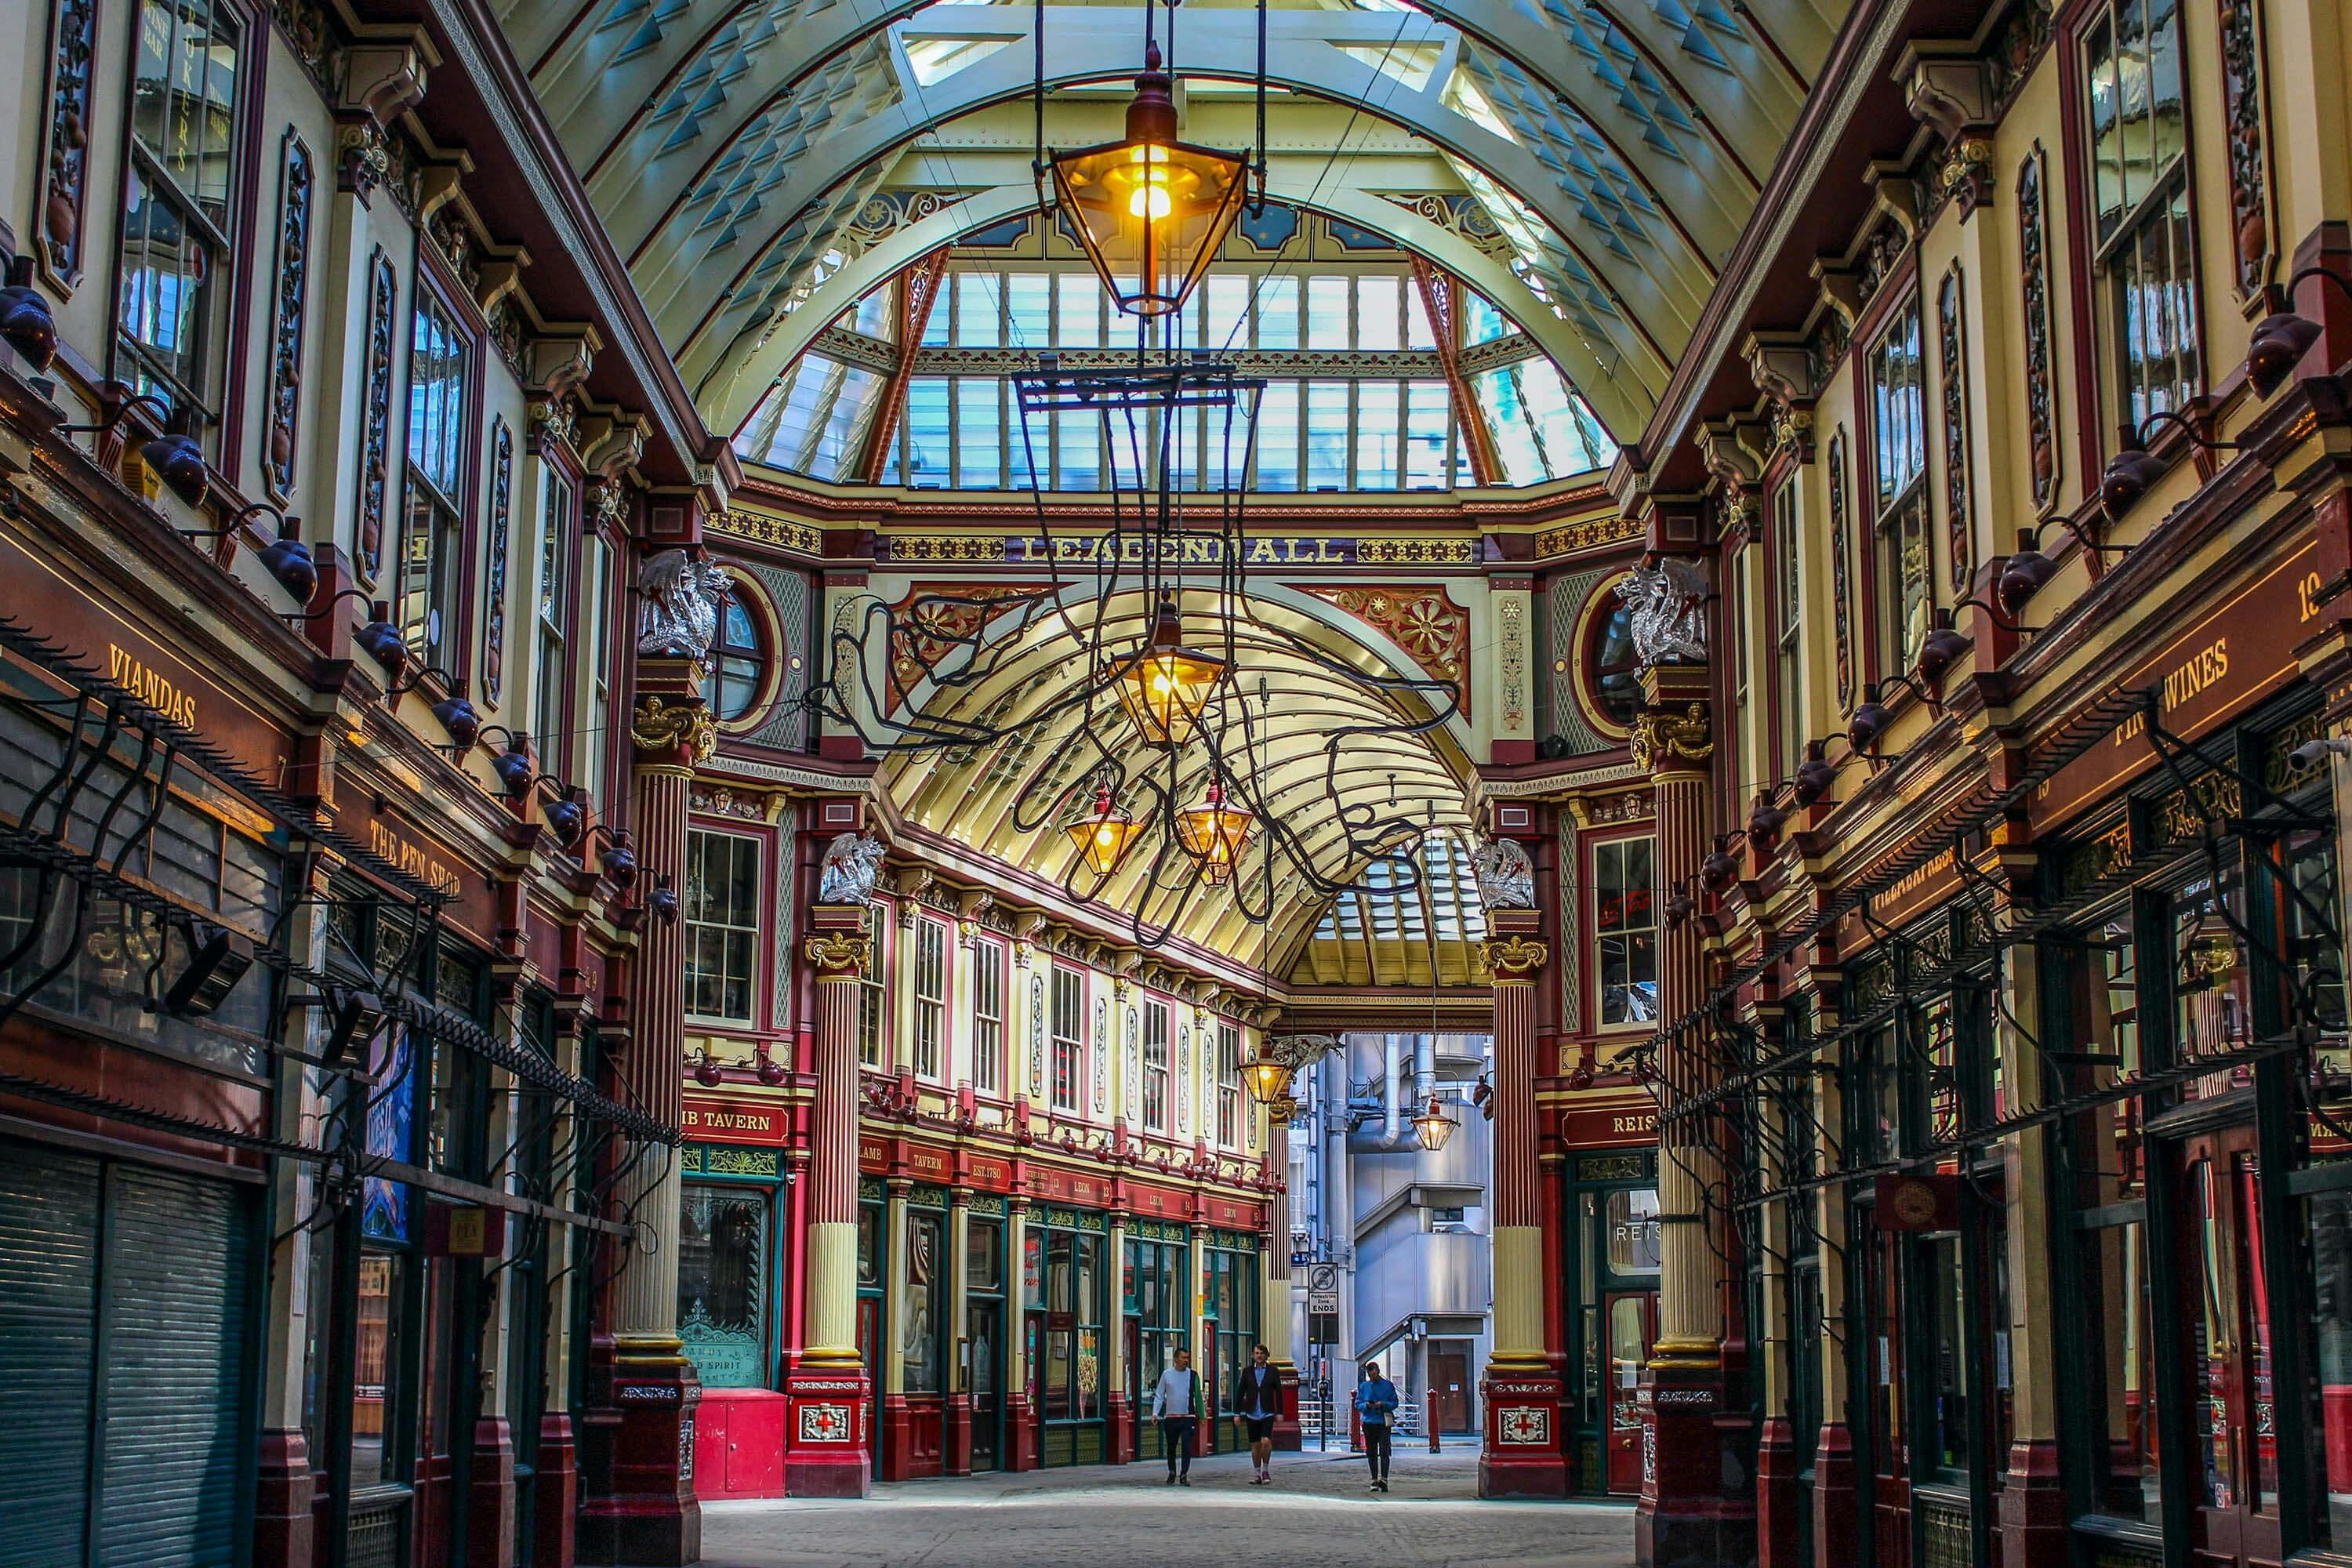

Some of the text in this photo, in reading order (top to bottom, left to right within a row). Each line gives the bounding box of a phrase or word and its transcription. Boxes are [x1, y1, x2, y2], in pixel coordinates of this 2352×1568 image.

[144, 0, 169, 42] WINE
[144, 24, 163, 61] BAR
[177, 0, 196, 172] ROKERS
[210, 109, 227, 142] BAR
[1022, 537, 1345, 563] LEADENHALL
[110, 643, 196, 732] VIANDAS
[2163, 637, 2230, 713] WINES
[371, 818, 461, 897] THE PEN SHOP
[704, 1112, 771, 1131] TAVERN
[859, 1145, 882, 1160] LAMB
[914, 1154, 942, 1170] TAVERN
[1074, 1181, 1091, 1194] LEON
[1150, 1195, 1164, 1207] LEON
[1224, 1207, 1236, 1218] LEON
